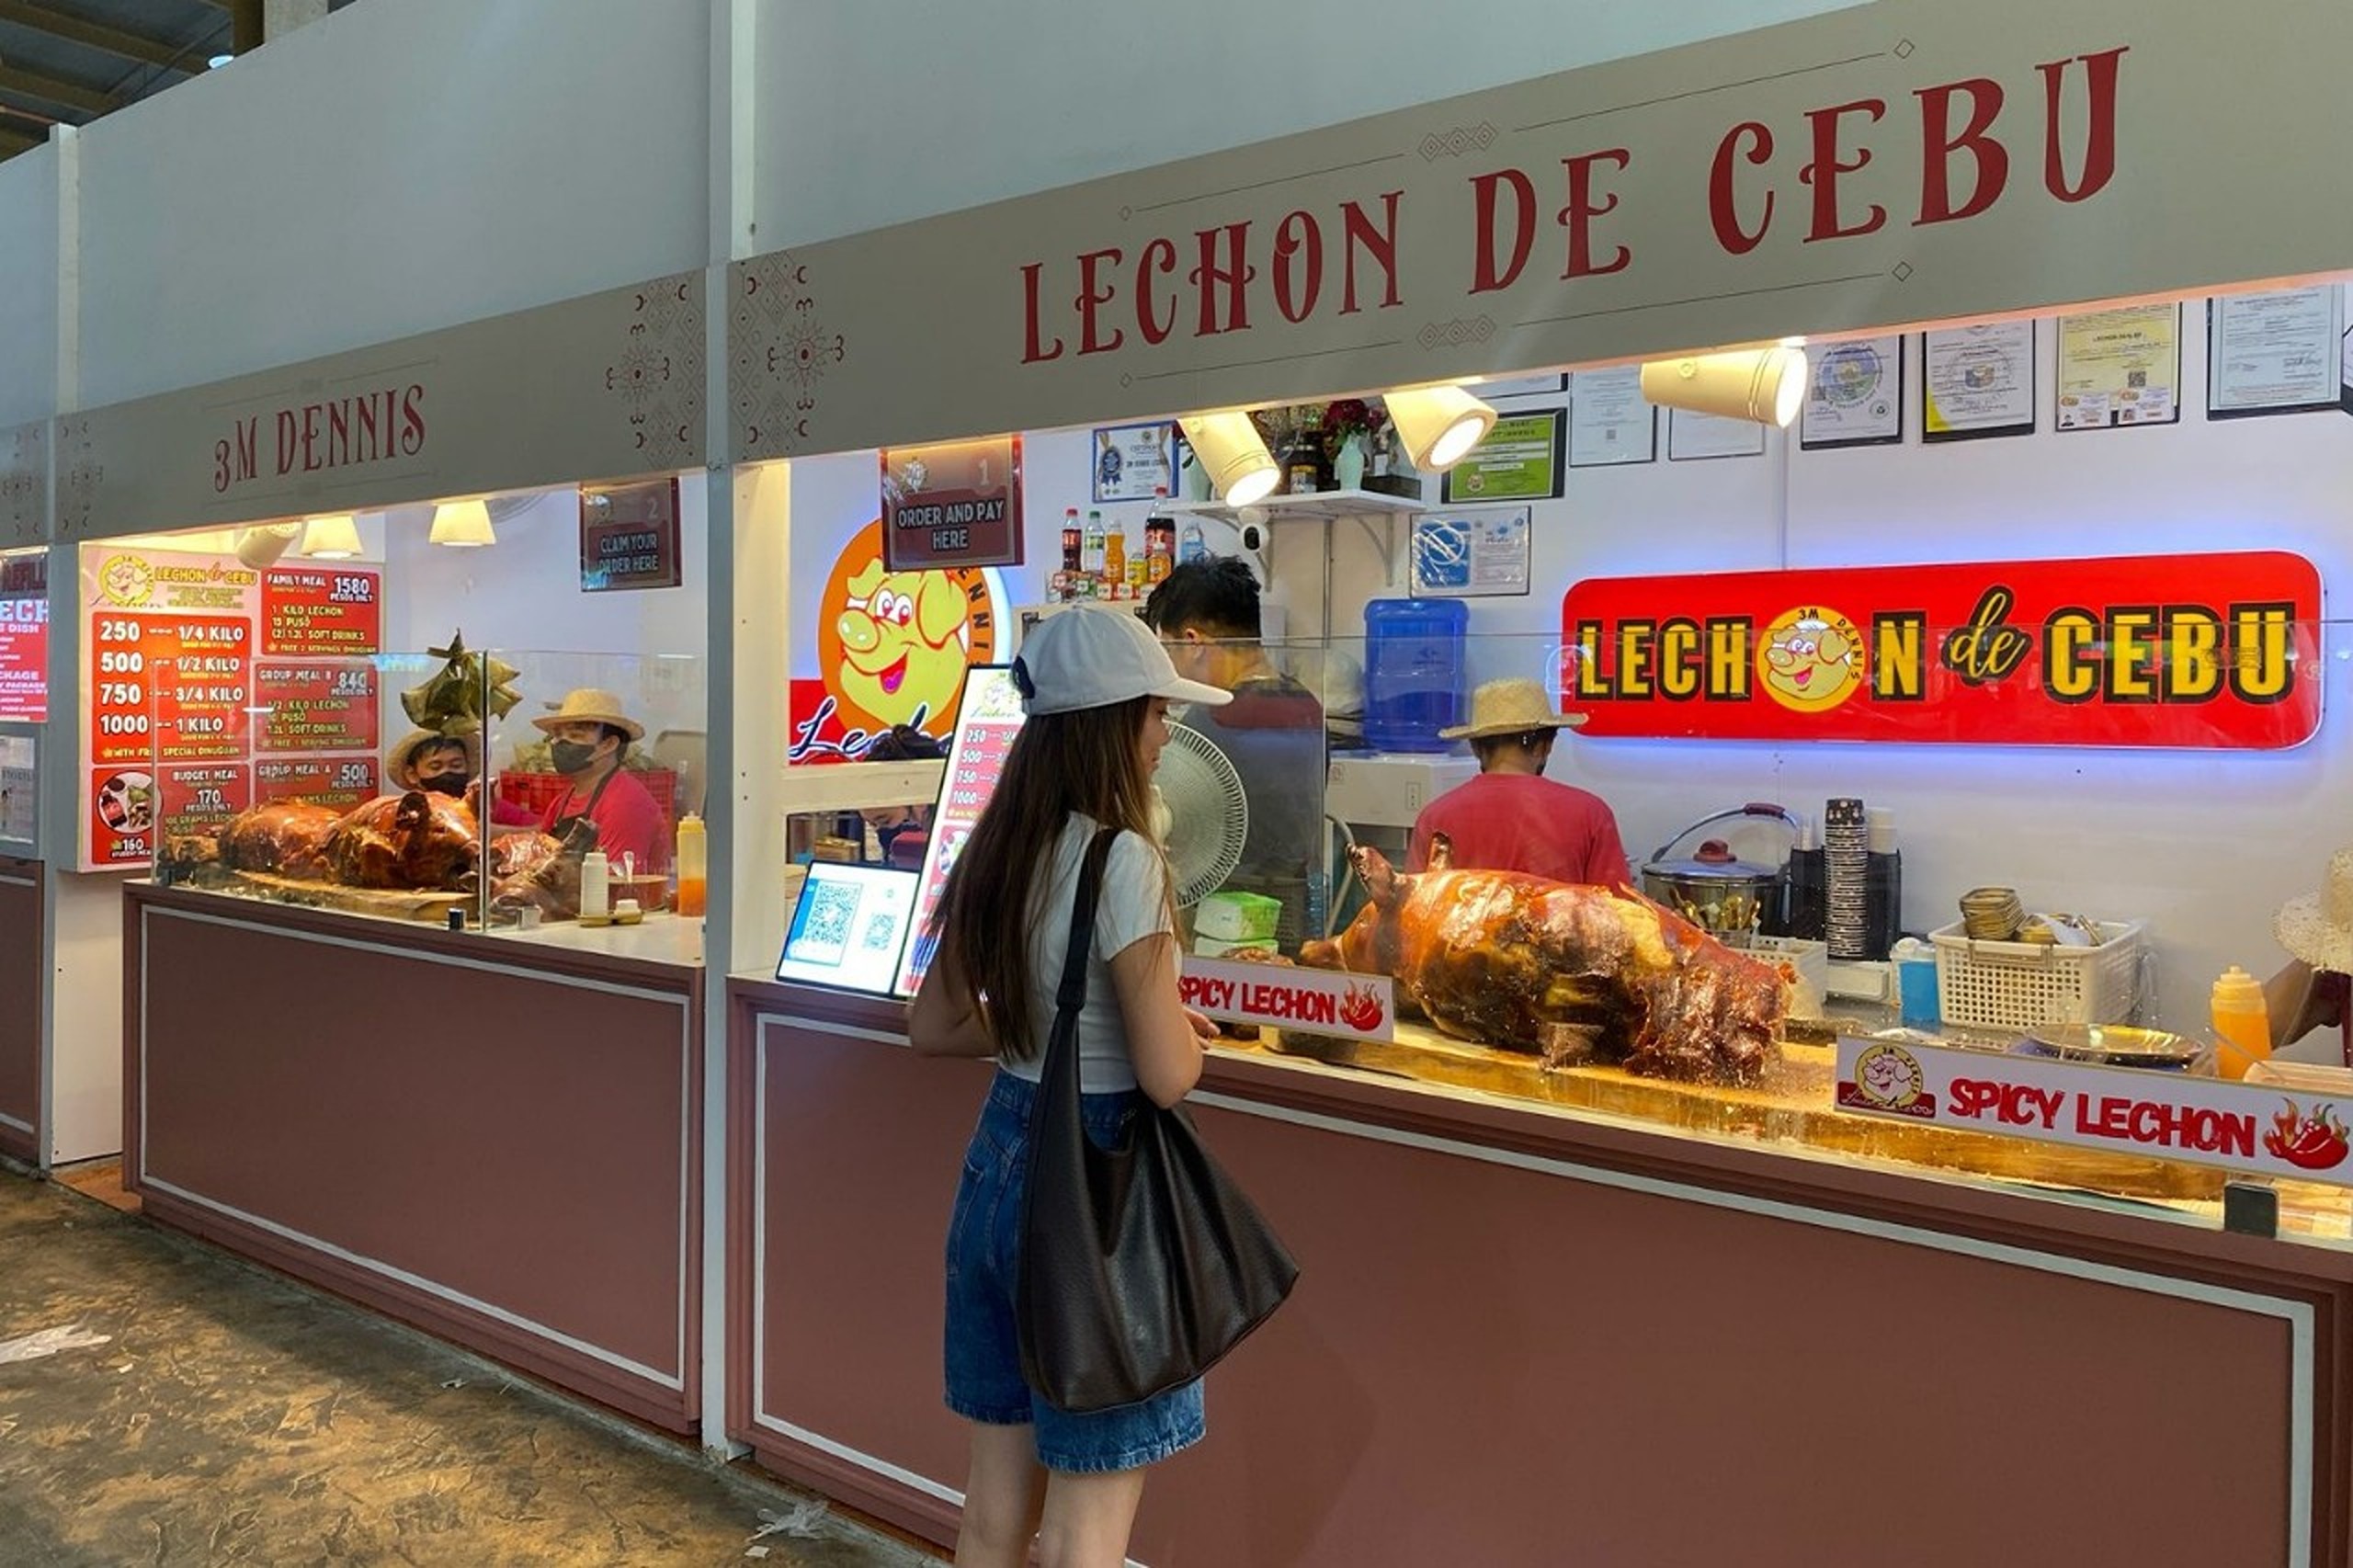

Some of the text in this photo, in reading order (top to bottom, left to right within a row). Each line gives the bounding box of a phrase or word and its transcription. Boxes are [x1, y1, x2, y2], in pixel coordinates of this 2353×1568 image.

[1019, 46, 2131, 366] LECHON DE CEBU
[213, 384, 426, 494] 3M DENNIS
[978, 459, 990, 486] 1
[646, 497, 658, 519] 2
[897, 500, 1005, 528] ORDER AND PAY
[600, 533, 658, 553] CLAIM YOUR
[932, 529, 968, 551] HERE
[598, 554, 659, 574] ORDER HERE
[154, 566, 206, 583] LECHON
[267, 574, 326, 586] FAMILY MEAL
[334, 576, 370, 595] 1580
[282, 605, 305, 616] KILO
[307, 606, 345, 617] LECHON
[1798, 608, 1819, 620] 3M
[99, 620, 244, 642] 250 1/4 KILO
[1836, 618, 1863, 680] DENNIS
[1941, 585, 2033, 687] de
[2042, 601, 2296, 705] CEBU
[100, 651, 241, 673] 500 1/2 KILO
[259, 669, 291, 681] GROUP
[295, 669, 321, 680] MEAL
[337, 672, 367, 688] 840
[99, 683, 244, 705] 750 3/4 KILO
[313, 699, 350, 710] LECHON
[99, 714, 223, 734] 1000 1 KILO
[966, 729, 986, 743] 250
[961, 750, 982, 763] 500
[173, 770, 238, 781] BUDGET MEAL
[295, 764, 320, 775] MEAL
[340, 764, 369, 781] 500
[957, 769, 977, 782] 750
[197, 789, 222, 804] 170
[953, 790, 977, 803] 1000
[122, 838, 144, 851] 160
[1177, 974, 1337, 1026] SPICY LECHON
[1948, 1077, 2256, 1158] SPICY LECHON
